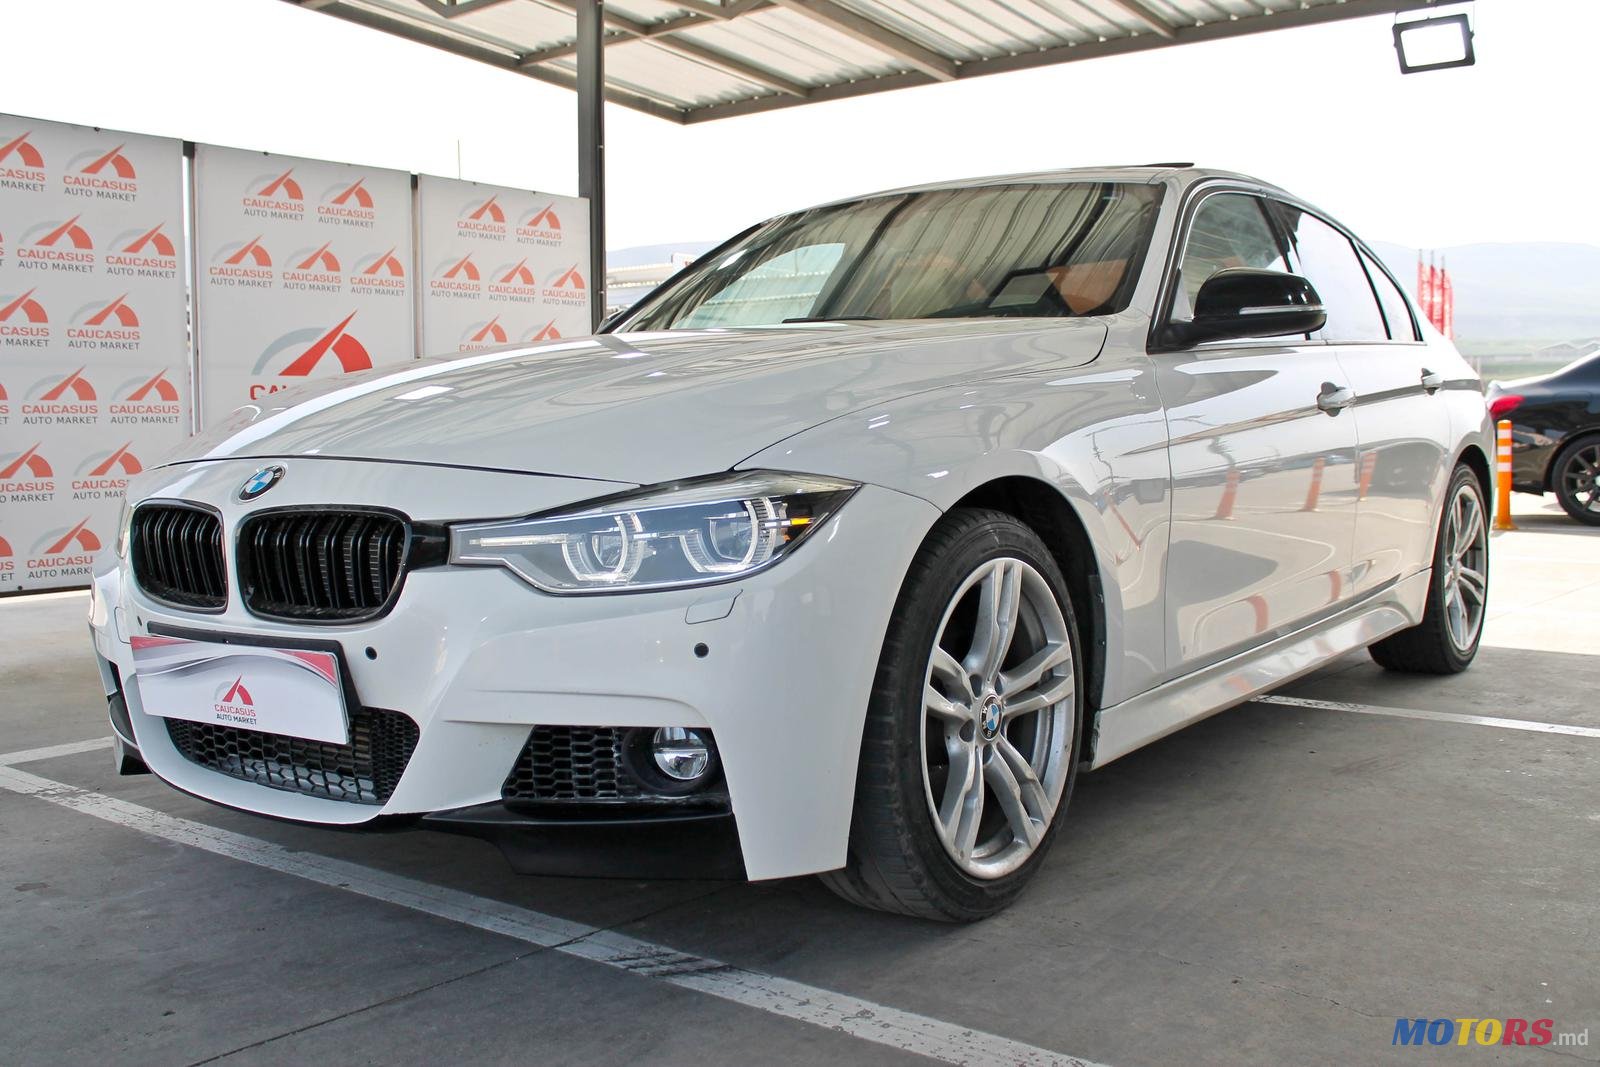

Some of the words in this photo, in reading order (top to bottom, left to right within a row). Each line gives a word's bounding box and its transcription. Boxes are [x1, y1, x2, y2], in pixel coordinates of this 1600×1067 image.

[1, 180, 46, 192] MARKET
[63, 175, 137, 192] CAUCASUS
[64, 187, 93, 198] AUTO
[96, 190, 137, 202] MARKET
[243, 198, 304, 212] CAUCASUS
[243, 208, 268, 218] AUTO
[270, 211, 304, 221] MARKET
[317, 206, 375, 220] CAUCASUS
[318, 216, 341, 225] AUTO
[343, 218, 375, 228] MARKET
[457, 221, 506, 234] CAUCASUS
[457, 230, 477, 239] AUTO
[479, 233, 506, 242] MARKET
[516, 228, 562, 240] CAUCASUS
[516, 237, 535, 245] AUTO
[536, 239, 562, 248] MARKET
[17, 248, 95, 263] CAUCASUS
[18, 260, 48, 271] AUTO
[52, 263, 95, 273] MARKET
[105, 255, 176, 269] CAUCASUS
[106, 266, 135, 277] AUTO
[137, 269, 176, 280] MARKET
[209, 267, 273, 280] CAUCASUS
[282, 272, 342, 284] CAUCASUS
[210, 277, 236, 287] AUTO
[238, 279, 273, 288] MARKET
[283, 282, 307, 291] AUTO
[308, 284, 342, 293] MARKET
[350, 277, 405, 289] CAUCASUS
[430, 280, 480, 292] CAUCASUS
[350, 286, 372, 295] AUTO
[374, 288, 405, 297] MARKET
[431, 290, 451, 298] AUTO
[453, 292, 481, 300] MARKET
[488, 284, 536, 296] CAUCASUS
[542, 289, 586, 300] CAUCASUS
[488, 294, 507, 302] AUTO
[509, 295, 536, 304] MARKET
[67, 328, 140, 341] CAUCASUS
[6, 338, 49, 347] MARKET
[68, 340, 97, 350] AUTO
[100, 341, 140, 350] MARKET
[22, 404, 98, 414] CAUCASUS
[109, 404, 180, 414] CAUCASUS
[23, 416, 52, 425] AUTO
[55, 416, 98, 425] MARKET
[110, 416, 138, 424] AUTO
[141, 416, 180, 424] MARKET
[11, 493, 55, 503] MARKET
[73, 491, 101, 501] AUTO
[28, 569, 57, 579] AUTO
[214, 704, 256, 717] CAUCASUS
[216, 713, 233, 722] AUTO
[233, 715, 257, 725] MARKET
